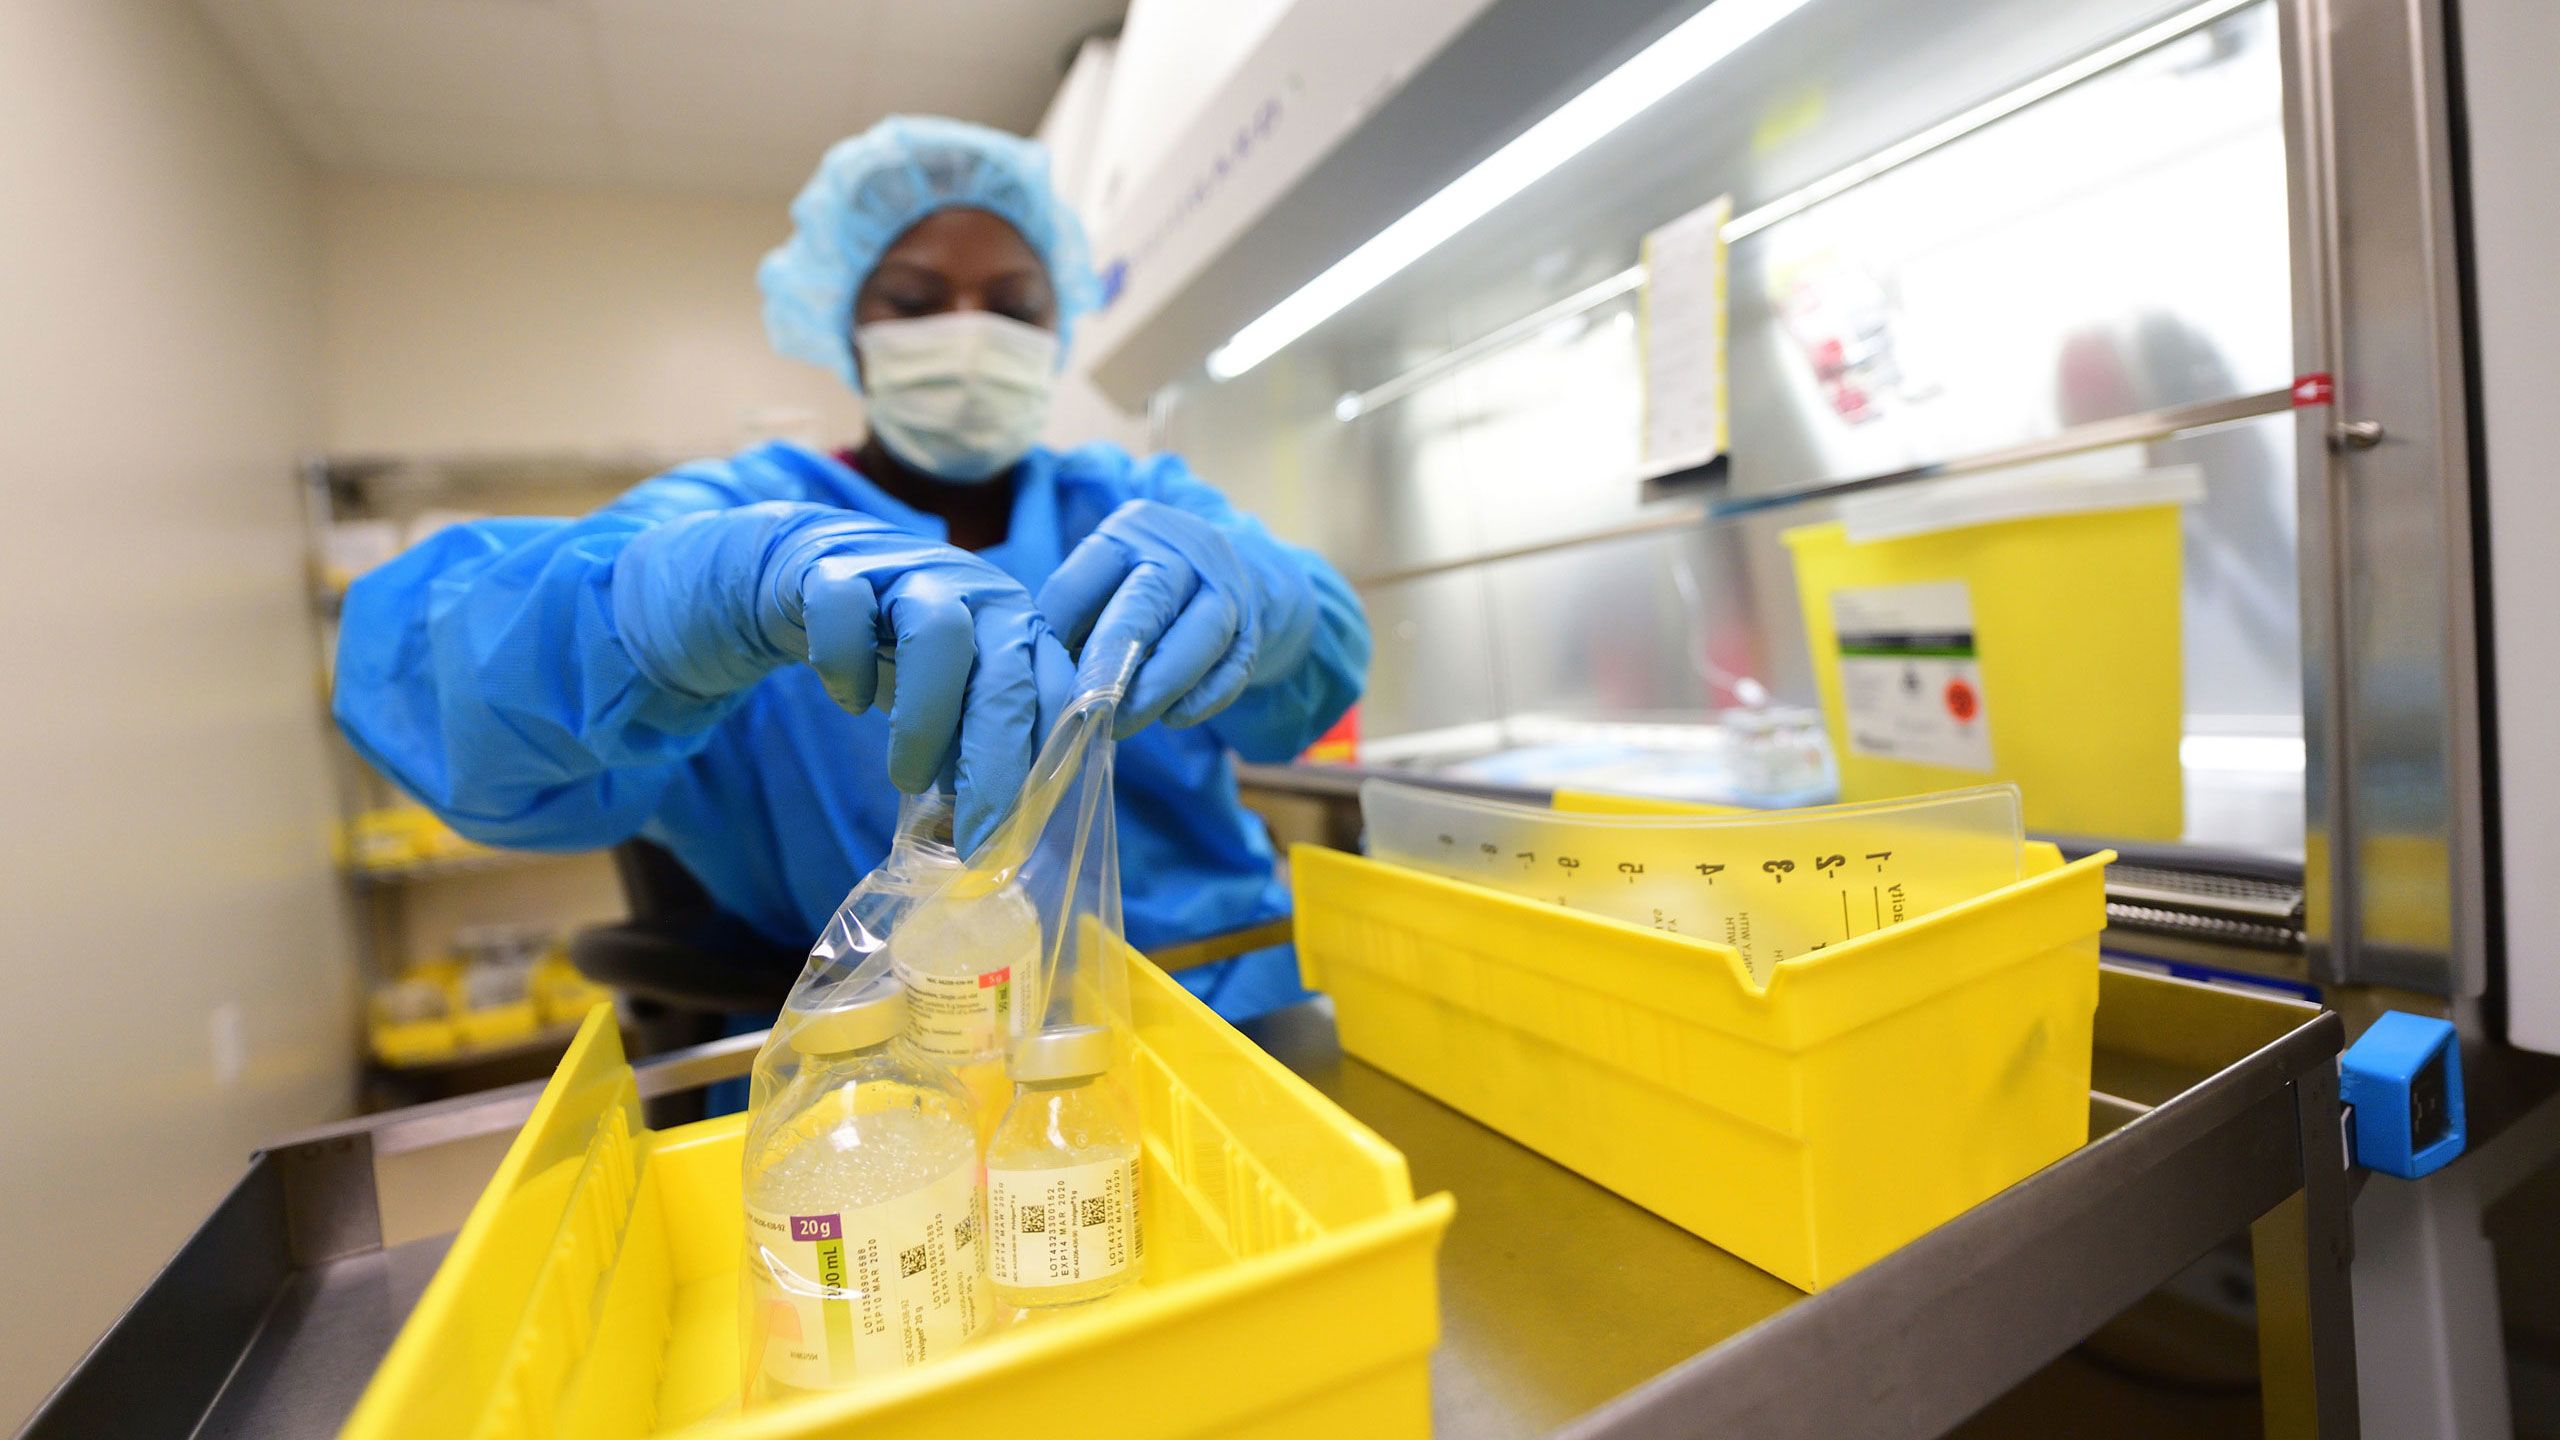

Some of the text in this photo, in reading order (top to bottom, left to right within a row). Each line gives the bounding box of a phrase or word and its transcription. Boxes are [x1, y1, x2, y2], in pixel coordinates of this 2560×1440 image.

[1057, 1180, 1066, 1205] 2020
[1058, 1212, 1067, 1236] MAR
[823, 1247, 840, 1269] mL
[868, 1238, 879, 1264] 2020
[871, 1270, 881, 1292] MAR
